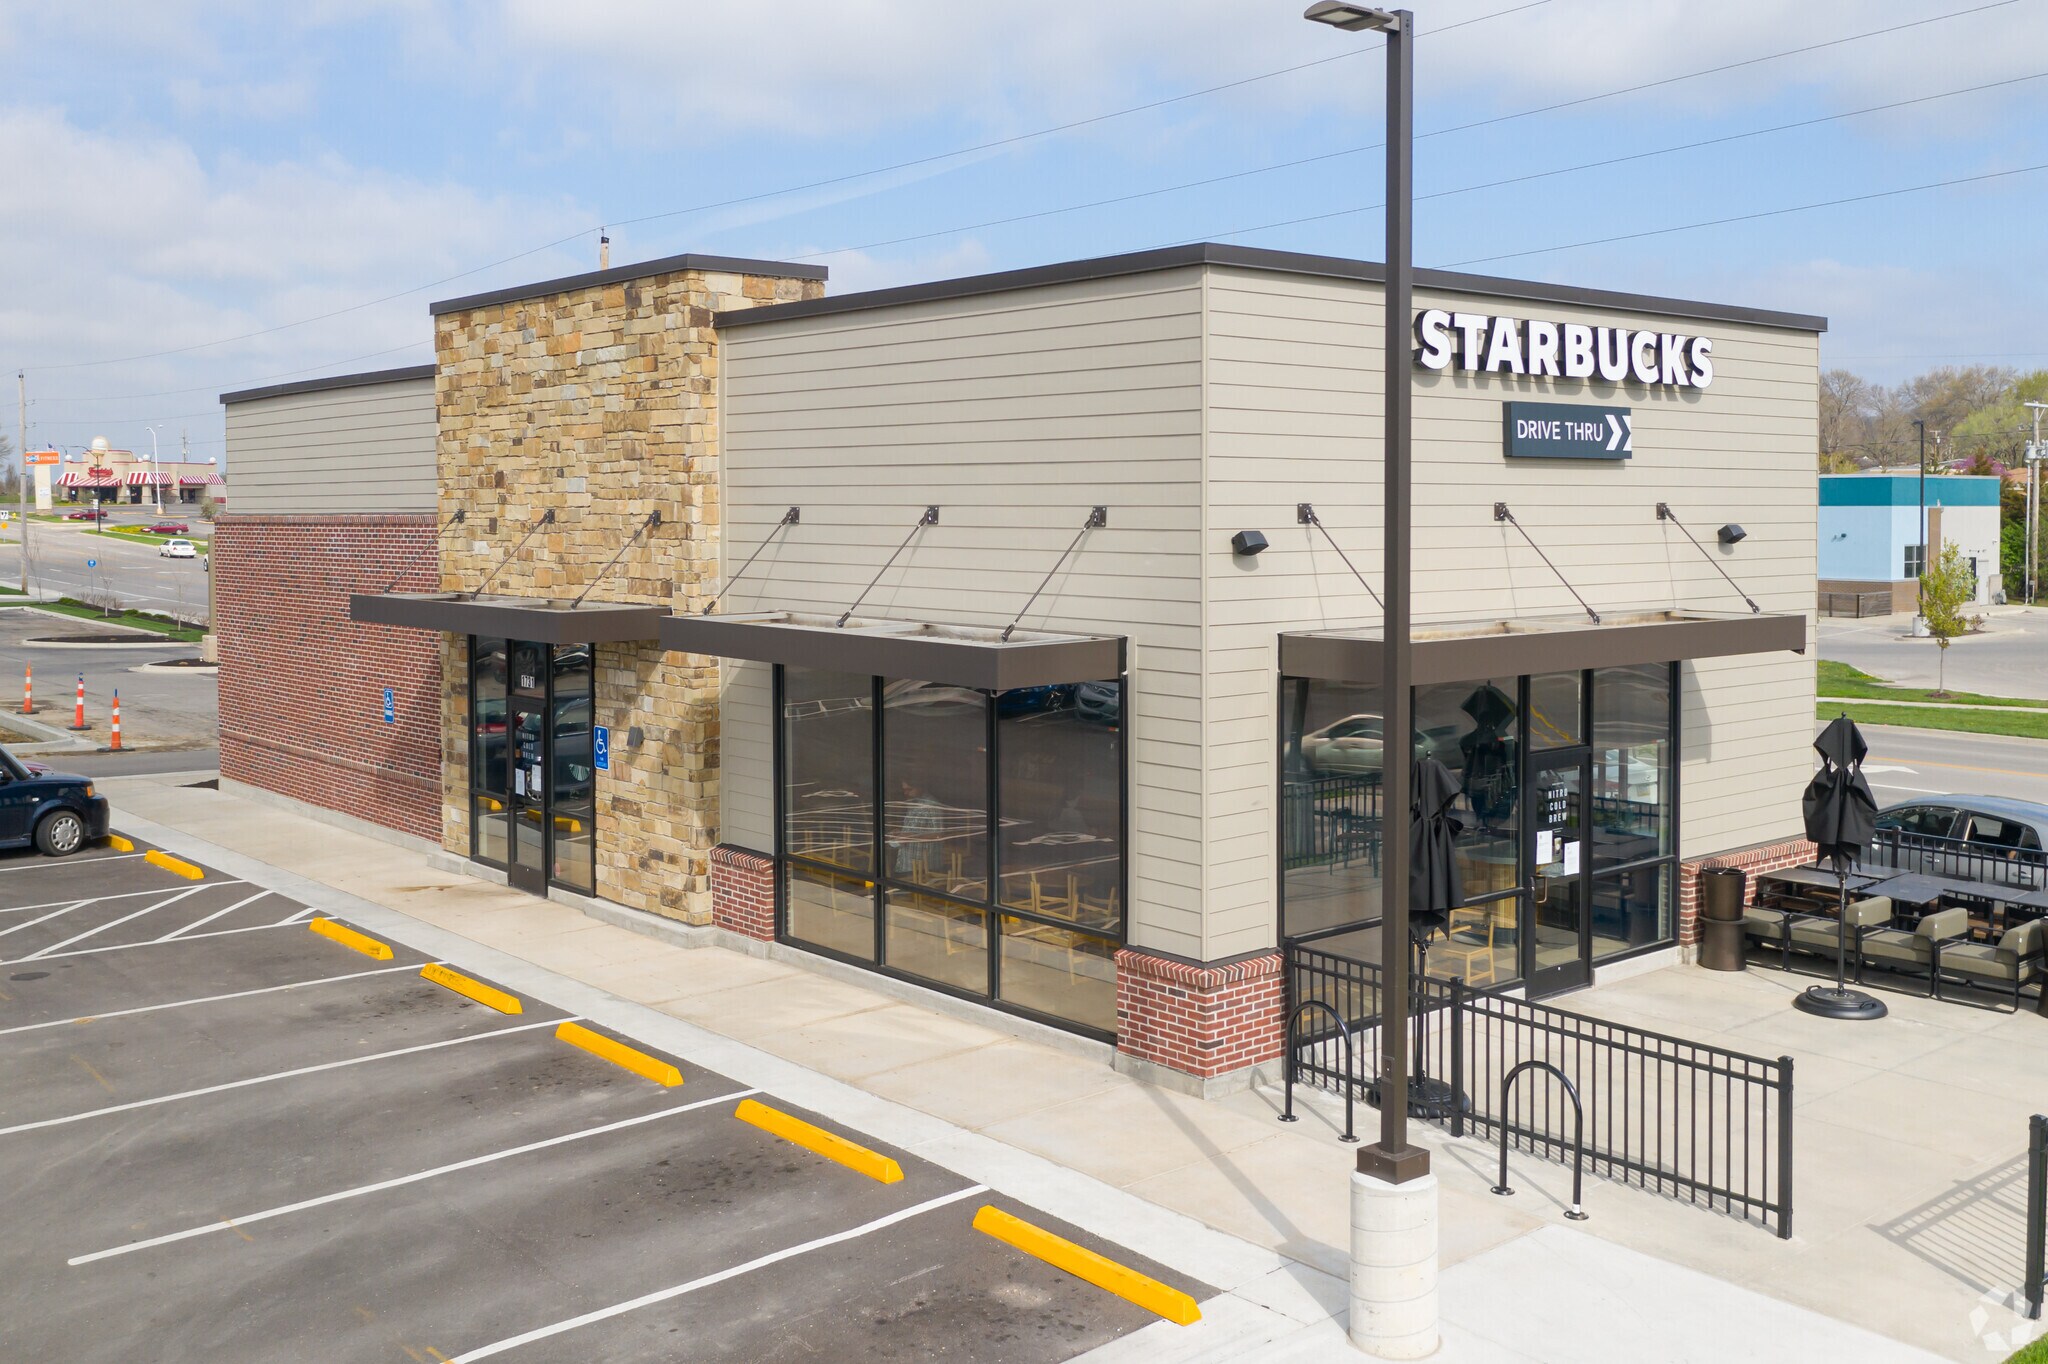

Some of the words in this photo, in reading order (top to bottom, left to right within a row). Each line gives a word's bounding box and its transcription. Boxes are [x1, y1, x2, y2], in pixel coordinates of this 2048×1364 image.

[1415, 308, 1715, 389] STARBUCKS
[1517, 419, 1561, 441] DRIVE
[1565, 422, 1603, 442] THRU
[521, 675, 534, 688] 1731
[1548, 788, 1568, 799] NITRO
[1549, 800, 1566, 811] COLD
[1548, 812, 1567, 824] BREW
